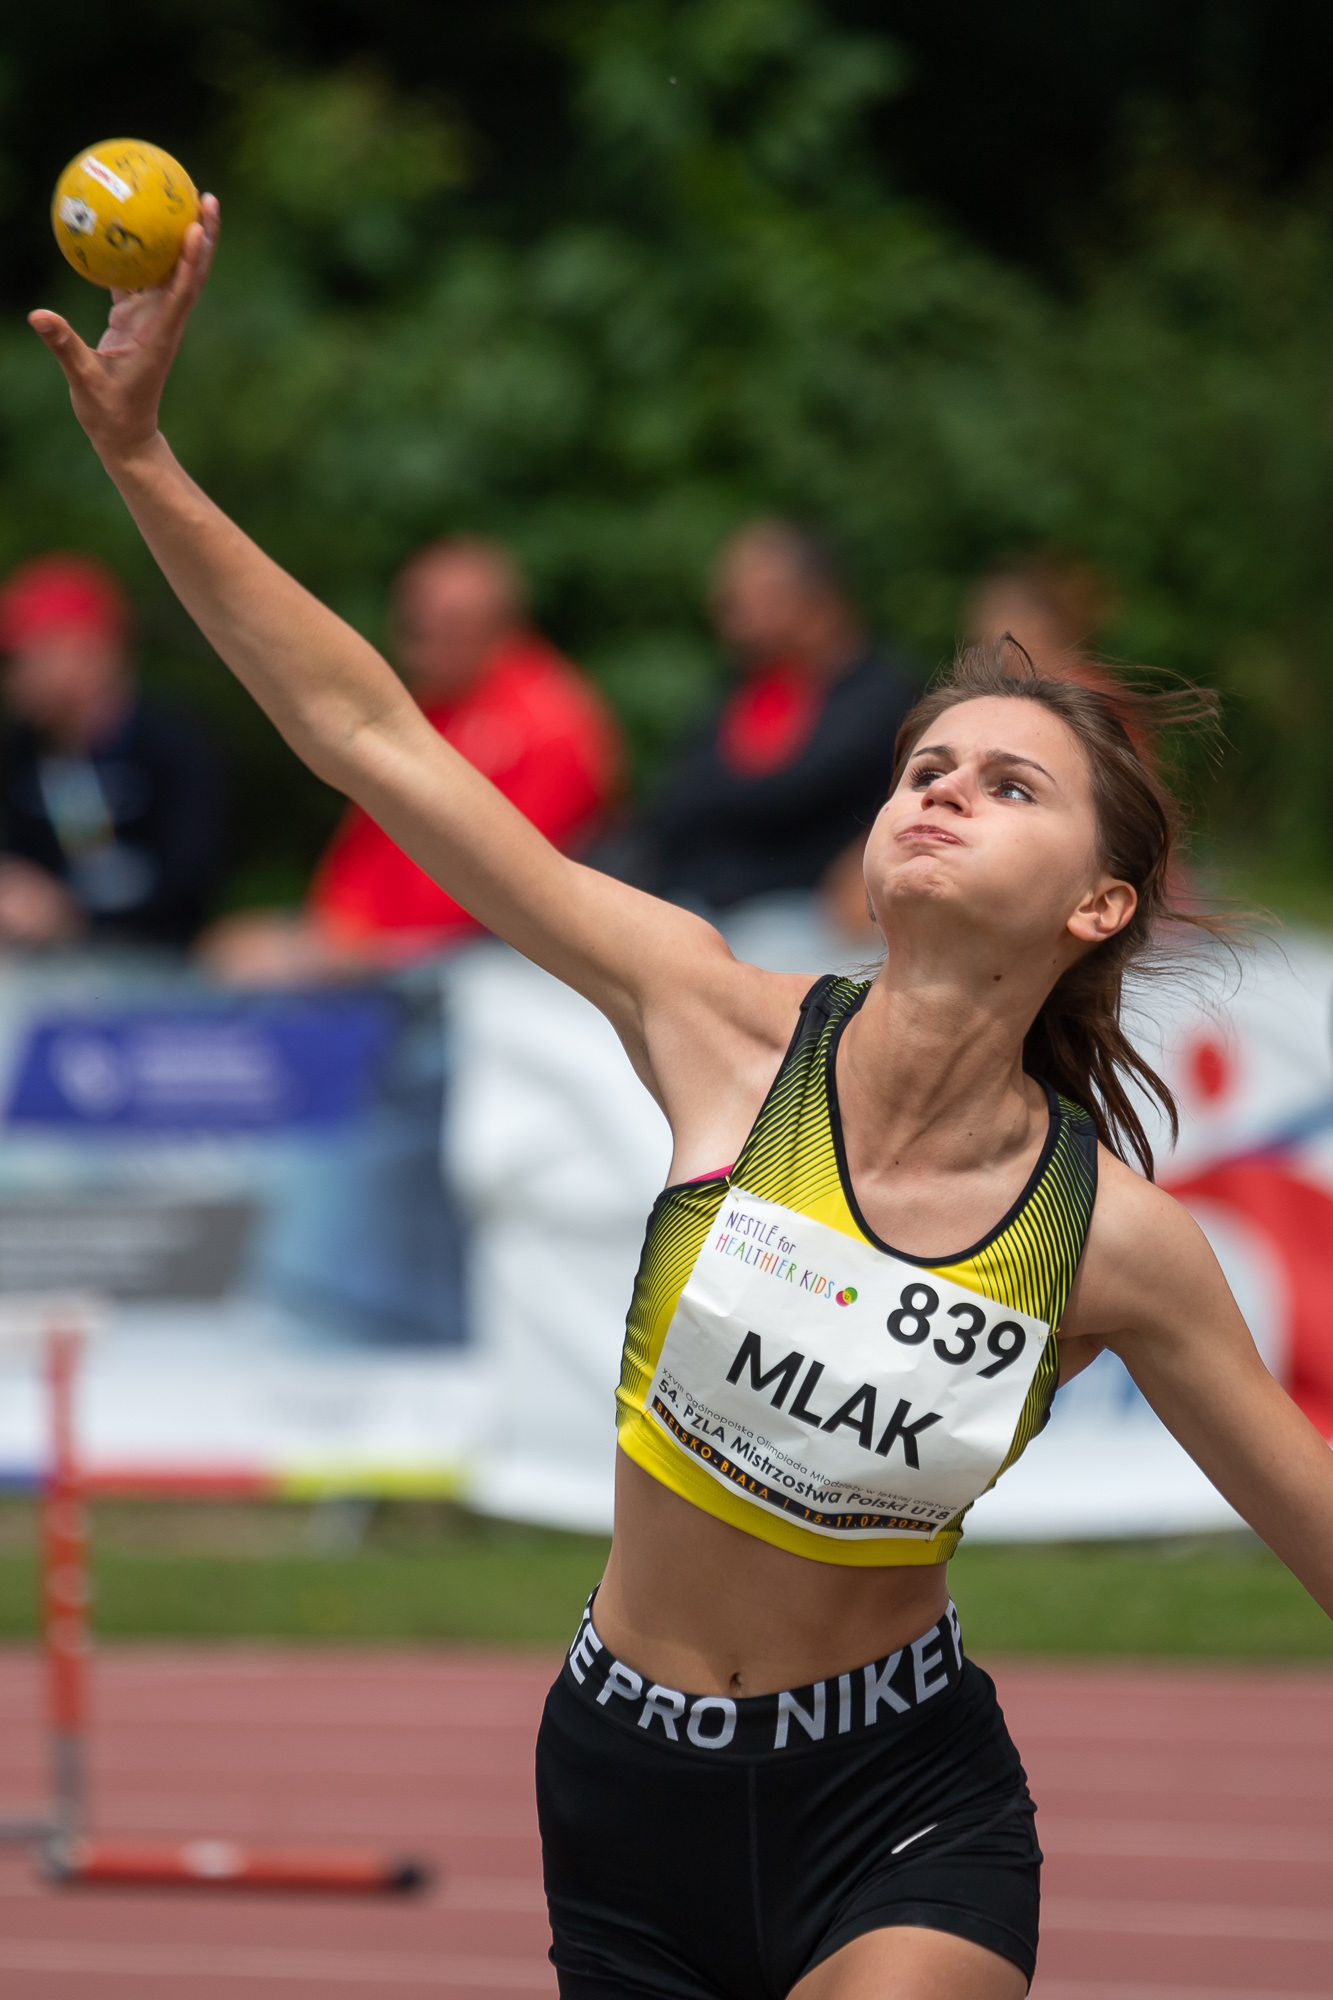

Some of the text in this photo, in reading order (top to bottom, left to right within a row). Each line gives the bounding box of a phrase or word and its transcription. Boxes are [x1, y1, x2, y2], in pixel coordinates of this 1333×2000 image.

[715, 1233, 835, 1299] HEALTHIER KIDS
[777, 1236, 796, 1255] for
[886, 1282, 1026, 1380] 839
[686, 1392, 754, 1439] Ogólnopolska
[756, 1436, 808, 1475] Olimpiada
[726, 1330, 944, 1470] MLAK
[658, 1379, 951, 1521] 54. PZLA Mistrzostwa Polski U18
[596, 1659, 737, 1750] PRO
[774, 1625, 949, 1750] NIKE
